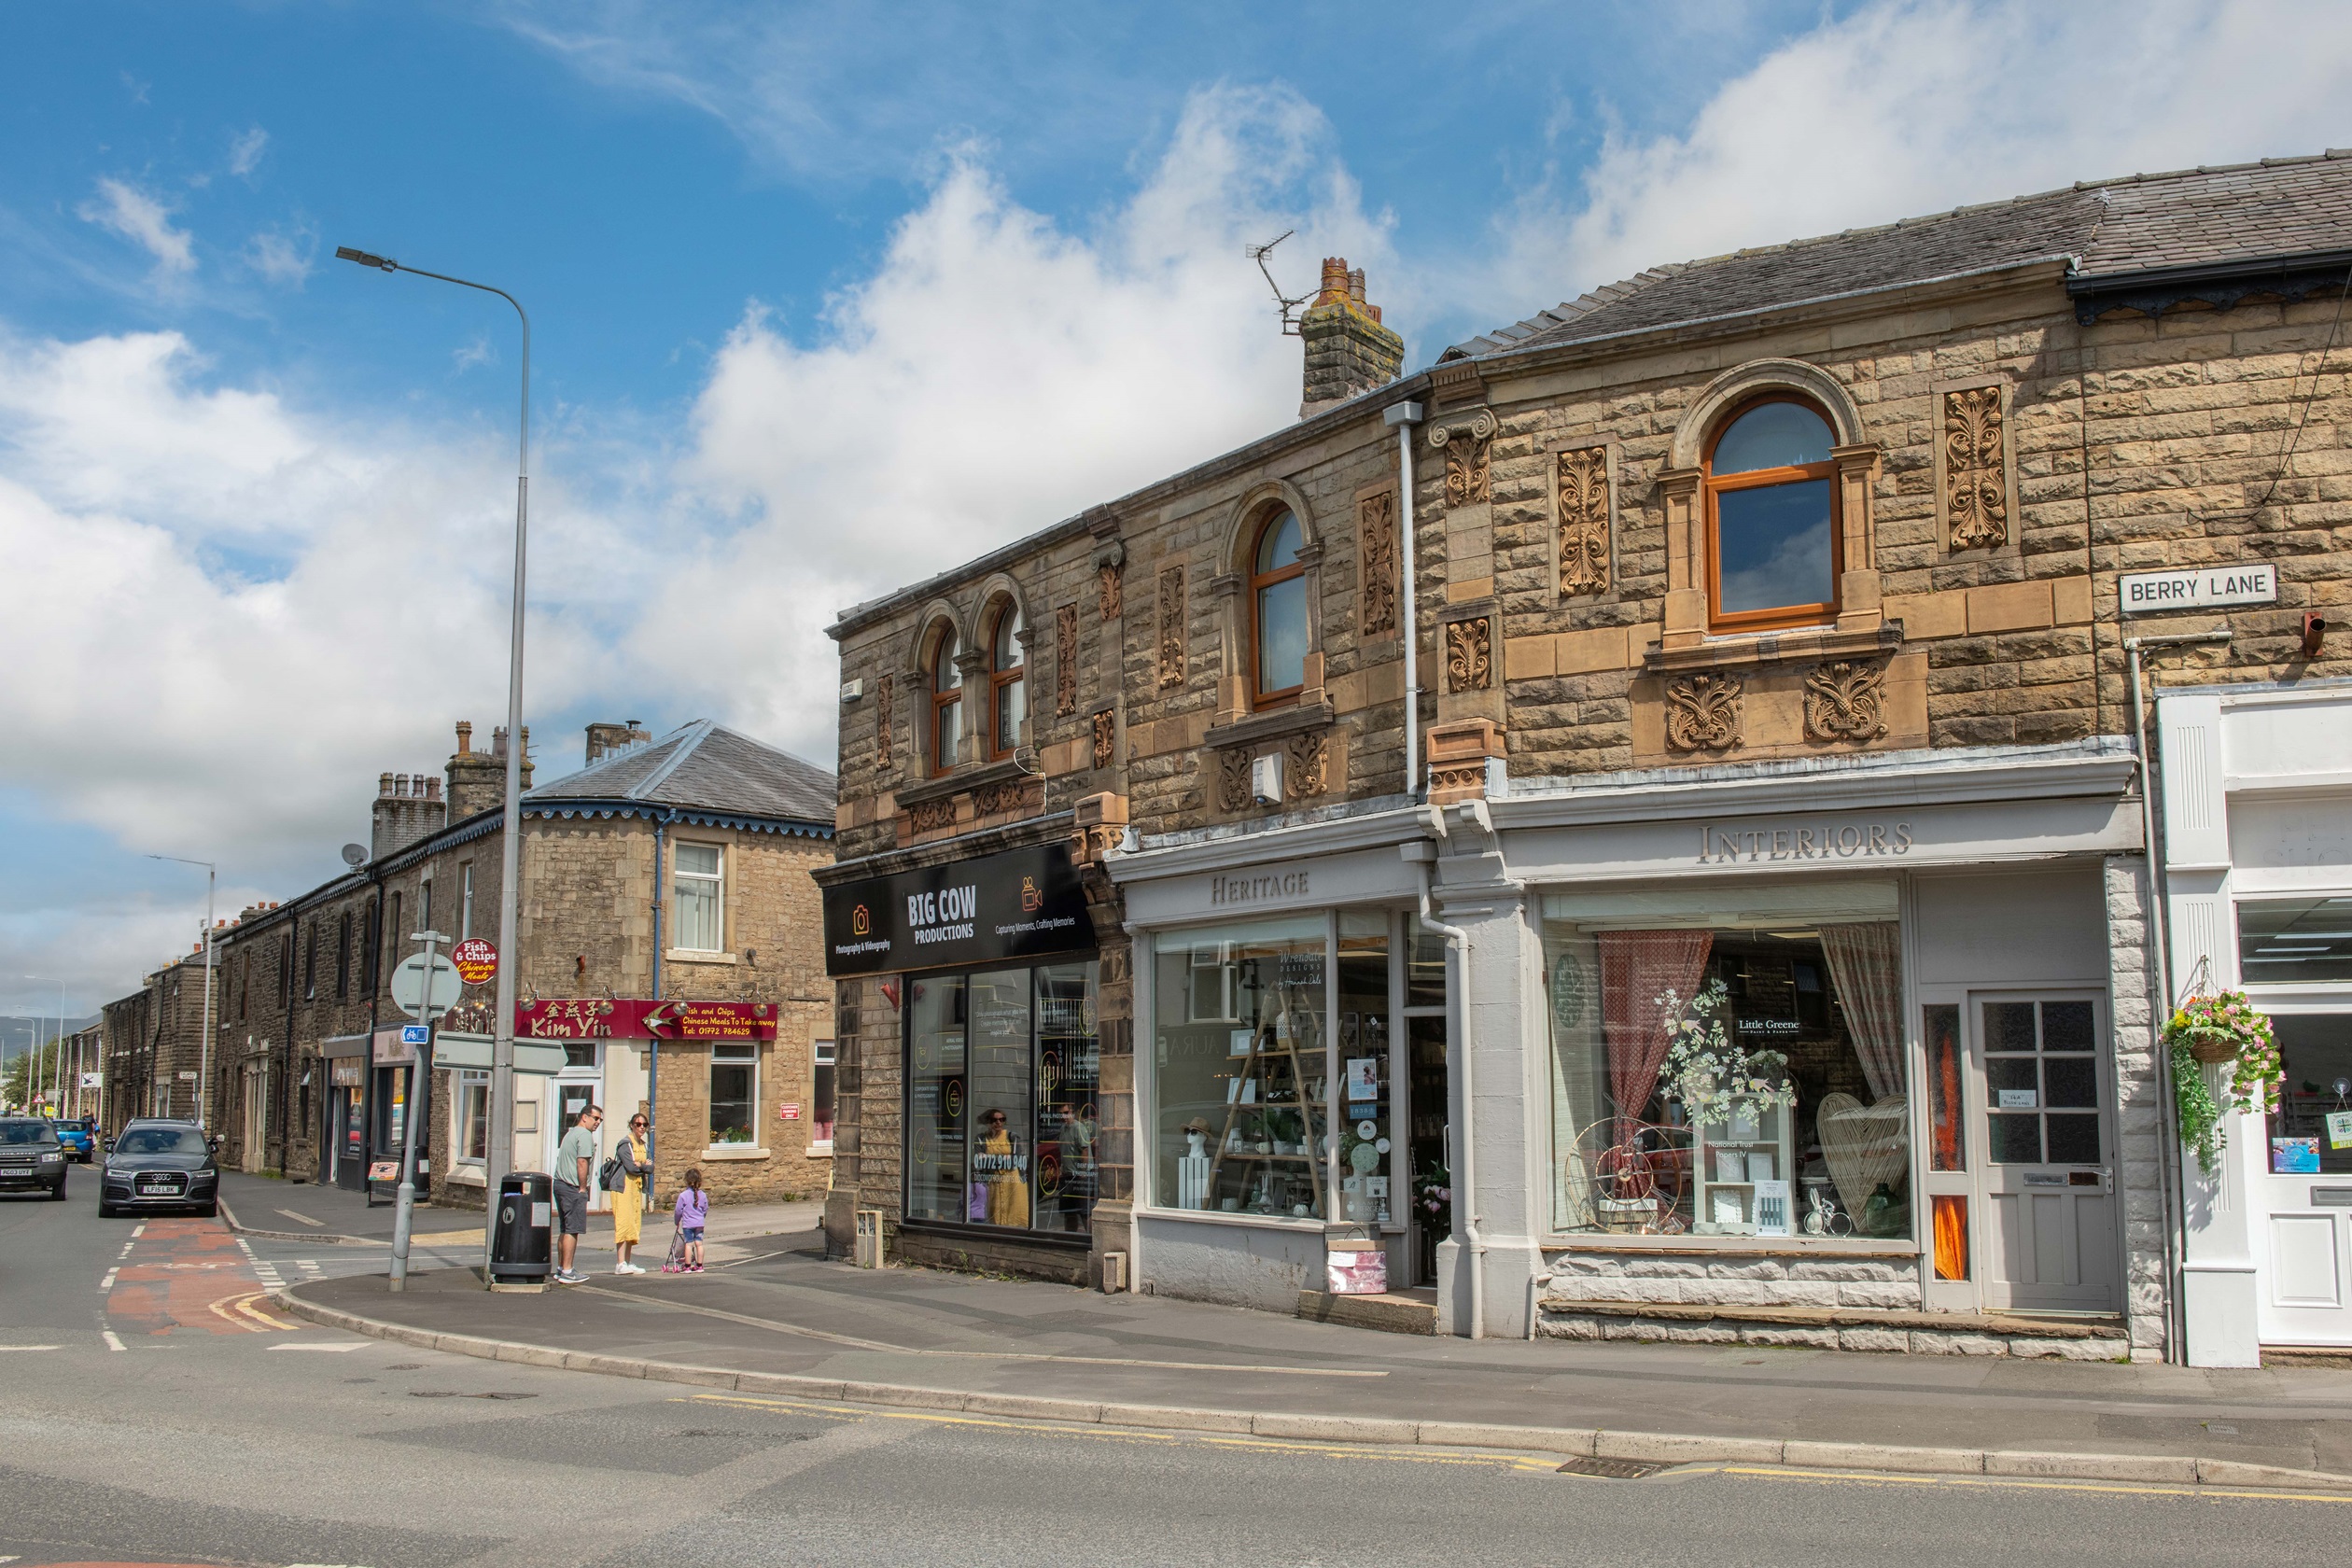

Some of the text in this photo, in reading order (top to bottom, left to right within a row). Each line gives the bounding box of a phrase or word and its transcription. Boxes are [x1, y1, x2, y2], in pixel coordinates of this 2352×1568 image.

[2130, 574, 2267, 602] BERRY LANE
[1697, 822, 1912, 859] INTERIORS
[1211, 872, 1309, 903] HERITAGE
[907, 885, 976, 927] BIG COW
[995, 916, 1075, 934] Capturing Moments, Crafting Memories
[915, 922, 974, 945] PRODUCTIONS
[464, 942, 488, 952] Fish
[835, 939, 890, 955] Photography & Videography
[456, 951, 497, 963] & Chips
[1278, 948, 1323, 964] Wrendale
[457, 961, 495, 973] Chinese
[1280, 963, 1321, 973] DESIGNS
[464, 972, 489, 981] Meals
[1284, 974, 1308, 987] Hannah
[1308, 973, 1322, 985] Dale
[701, 1007, 714, 1015] and
[717, 1007, 735, 1016] Chips
[531, 1016, 612, 1038] Kim Yin
[682, 1016, 709, 1025] Chinese
[709, 1017, 731, 1026] Meals
[1739, 1019, 1799, 1029] Little Greene
[682, 1027, 750, 1036] Tel: 01772 784629
[973, 1153, 1028, 1170] 01772 910 940
[1715, 1151, 1738, 1159] Papers
